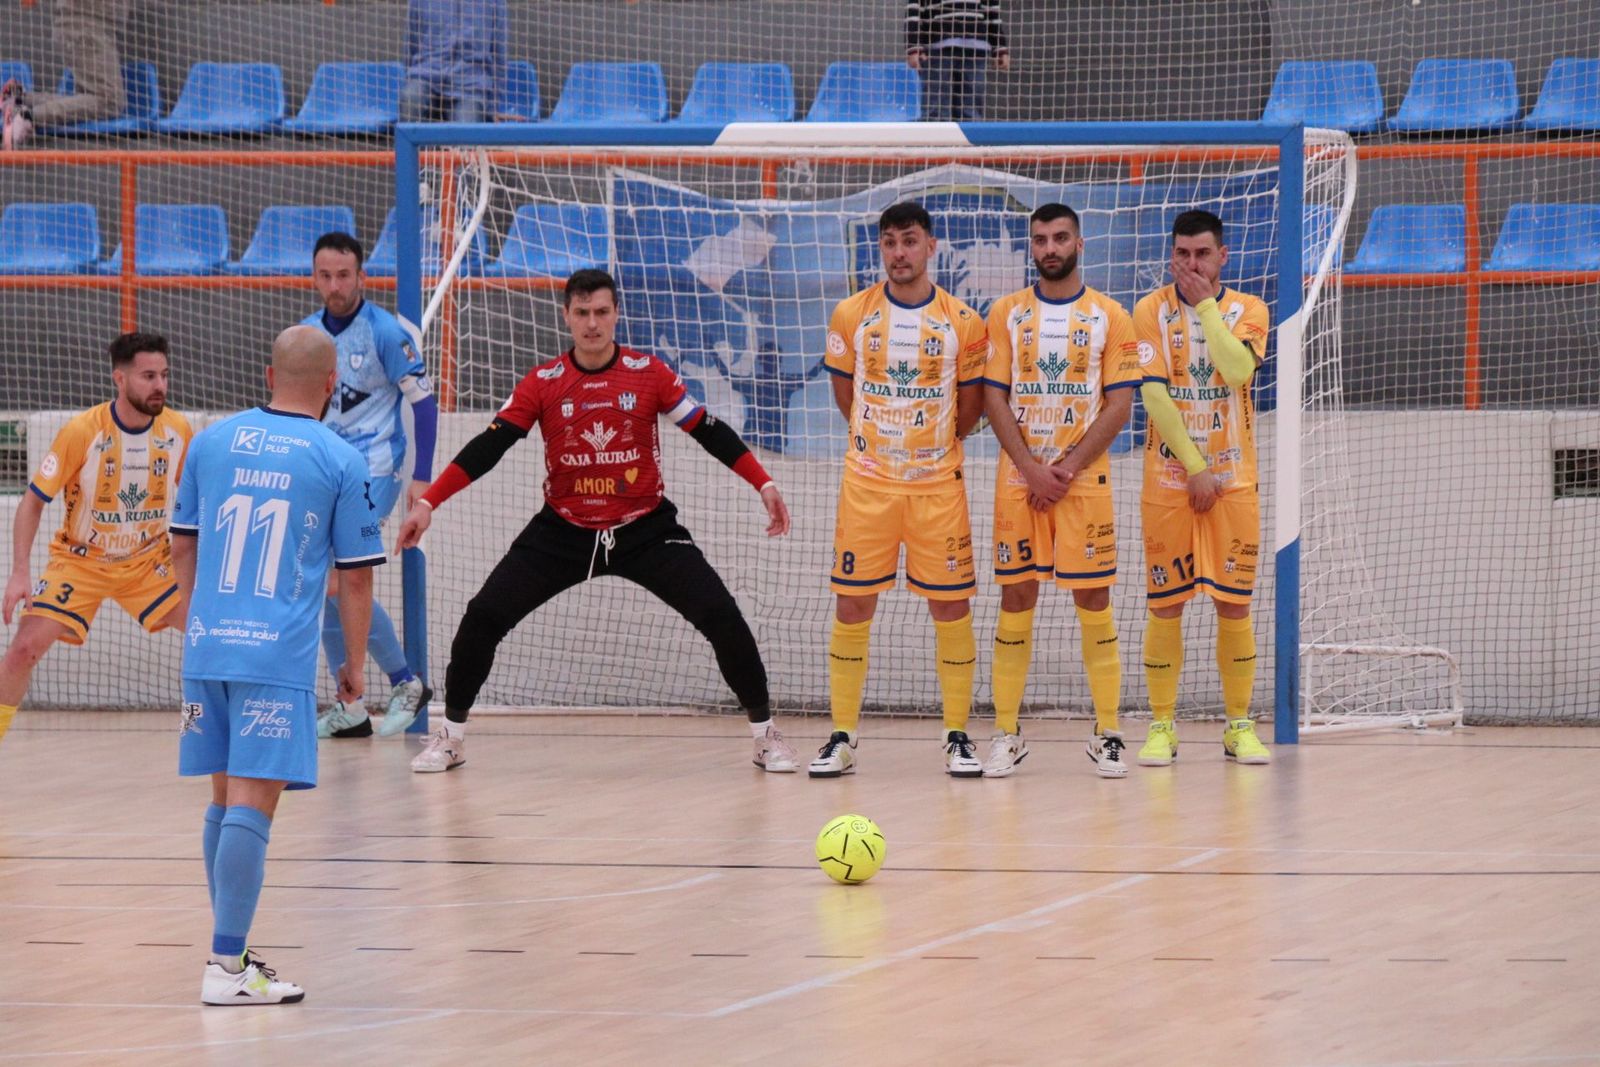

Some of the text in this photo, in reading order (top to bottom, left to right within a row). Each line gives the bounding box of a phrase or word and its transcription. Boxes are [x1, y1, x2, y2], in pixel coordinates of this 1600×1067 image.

[862, 381, 944, 399] CAJA RURAL
[1015, 383, 1092, 395] CAJA RURAL
[1168, 387, 1194, 400] CAJA
[1017, 407, 1074, 424] ZAMORA
[265, 444, 290, 454] PLUS
[268, 434, 311, 448] KITCHEN
[560, 448, 640, 466] CAJA RURAL
[232, 467, 292, 490] JUANTO
[92, 509, 166, 523] CAJA RURAL
[215, 493, 290, 598] 11
[1018, 539, 1032, 561] 5
[842, 551, 855, 575] 8
[1172, 553, 1194, 580] 12
[56, 582, 74, 605] 3
[209, 626, 280, 641] recoletas salud
[257, 726, 290, 738] .com
